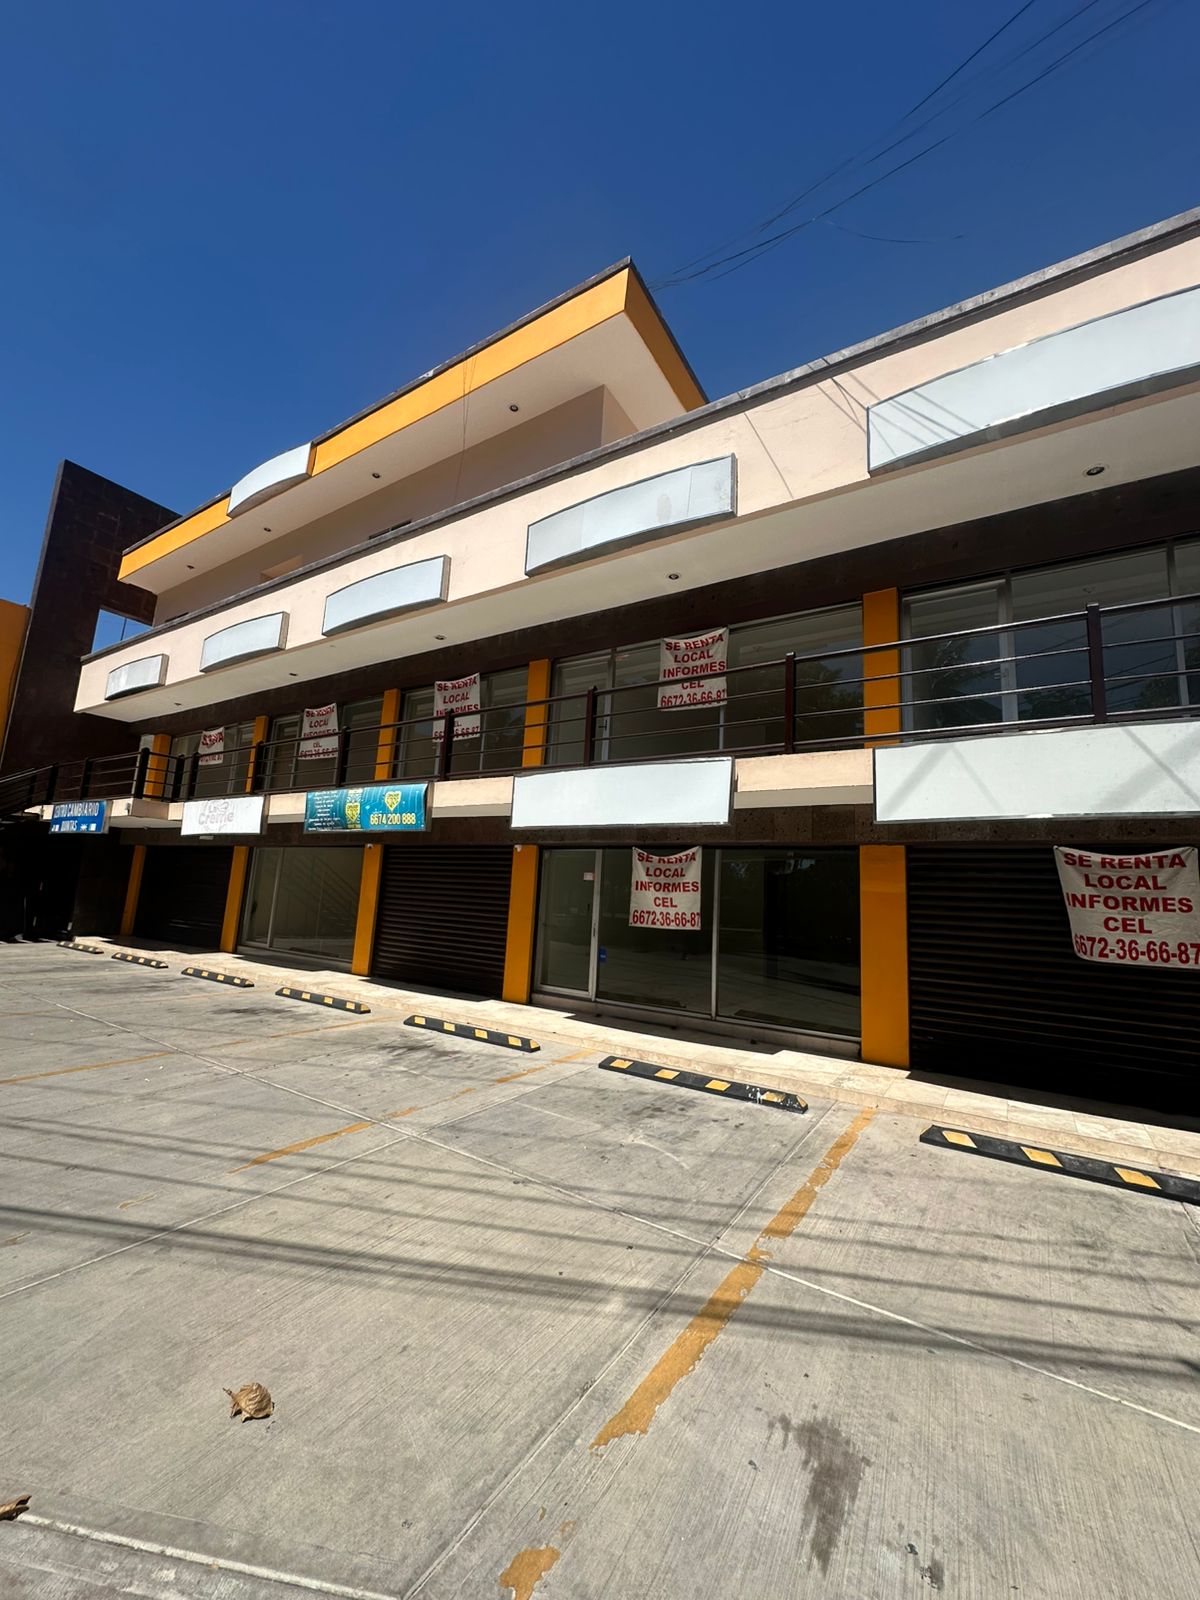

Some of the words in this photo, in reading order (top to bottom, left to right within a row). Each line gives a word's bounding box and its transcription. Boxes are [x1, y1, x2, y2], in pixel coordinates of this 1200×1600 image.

[665, 642, 681, 651] SE
[684, 634, 724, 650] RENTA
[674, 649, 713, 663] LOCAL
[663, 661, 726, 678] INFORMES
[437, 683, 449, 691] SE
[681, 680, 704, 690] CEL
[443, 692, 470, 704] LOCAL
[637, 852, 653, 863] SE
[657, 852, 697, 865] RENTA
[1063, 852, 1092, 868] SE
[1100, 853, 1187, 869] RENTA
[645, 867, 686, 878] LOCAL
[635, 880, 699, 893] INFORMES
[1084, 873, 1167, 890] LOCAL
[653, 896, 678, 908] CEL
[1065, 892, 1193, 913] INFORMES
[1103, 916, 1152, 934] CEL
